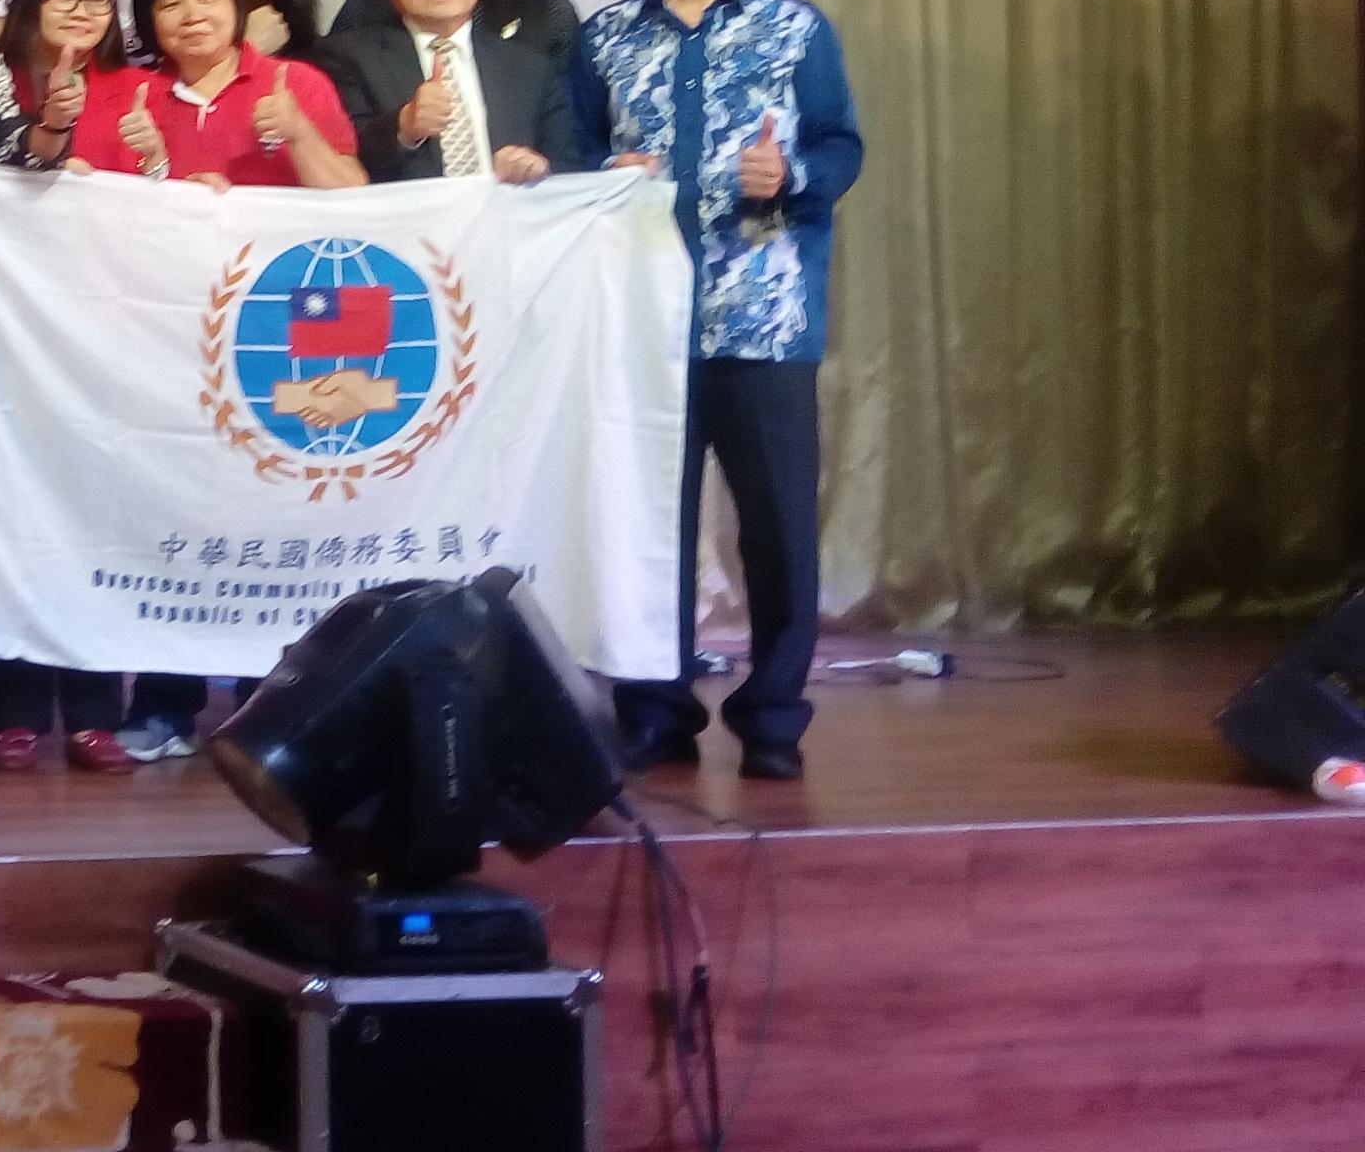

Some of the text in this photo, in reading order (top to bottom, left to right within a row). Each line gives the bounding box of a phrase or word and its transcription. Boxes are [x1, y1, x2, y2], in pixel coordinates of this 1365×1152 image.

[92, 568, 201, 595] Overseas
[138, 601, 242, 625] Republic
[257, 608, 280, 626] of
